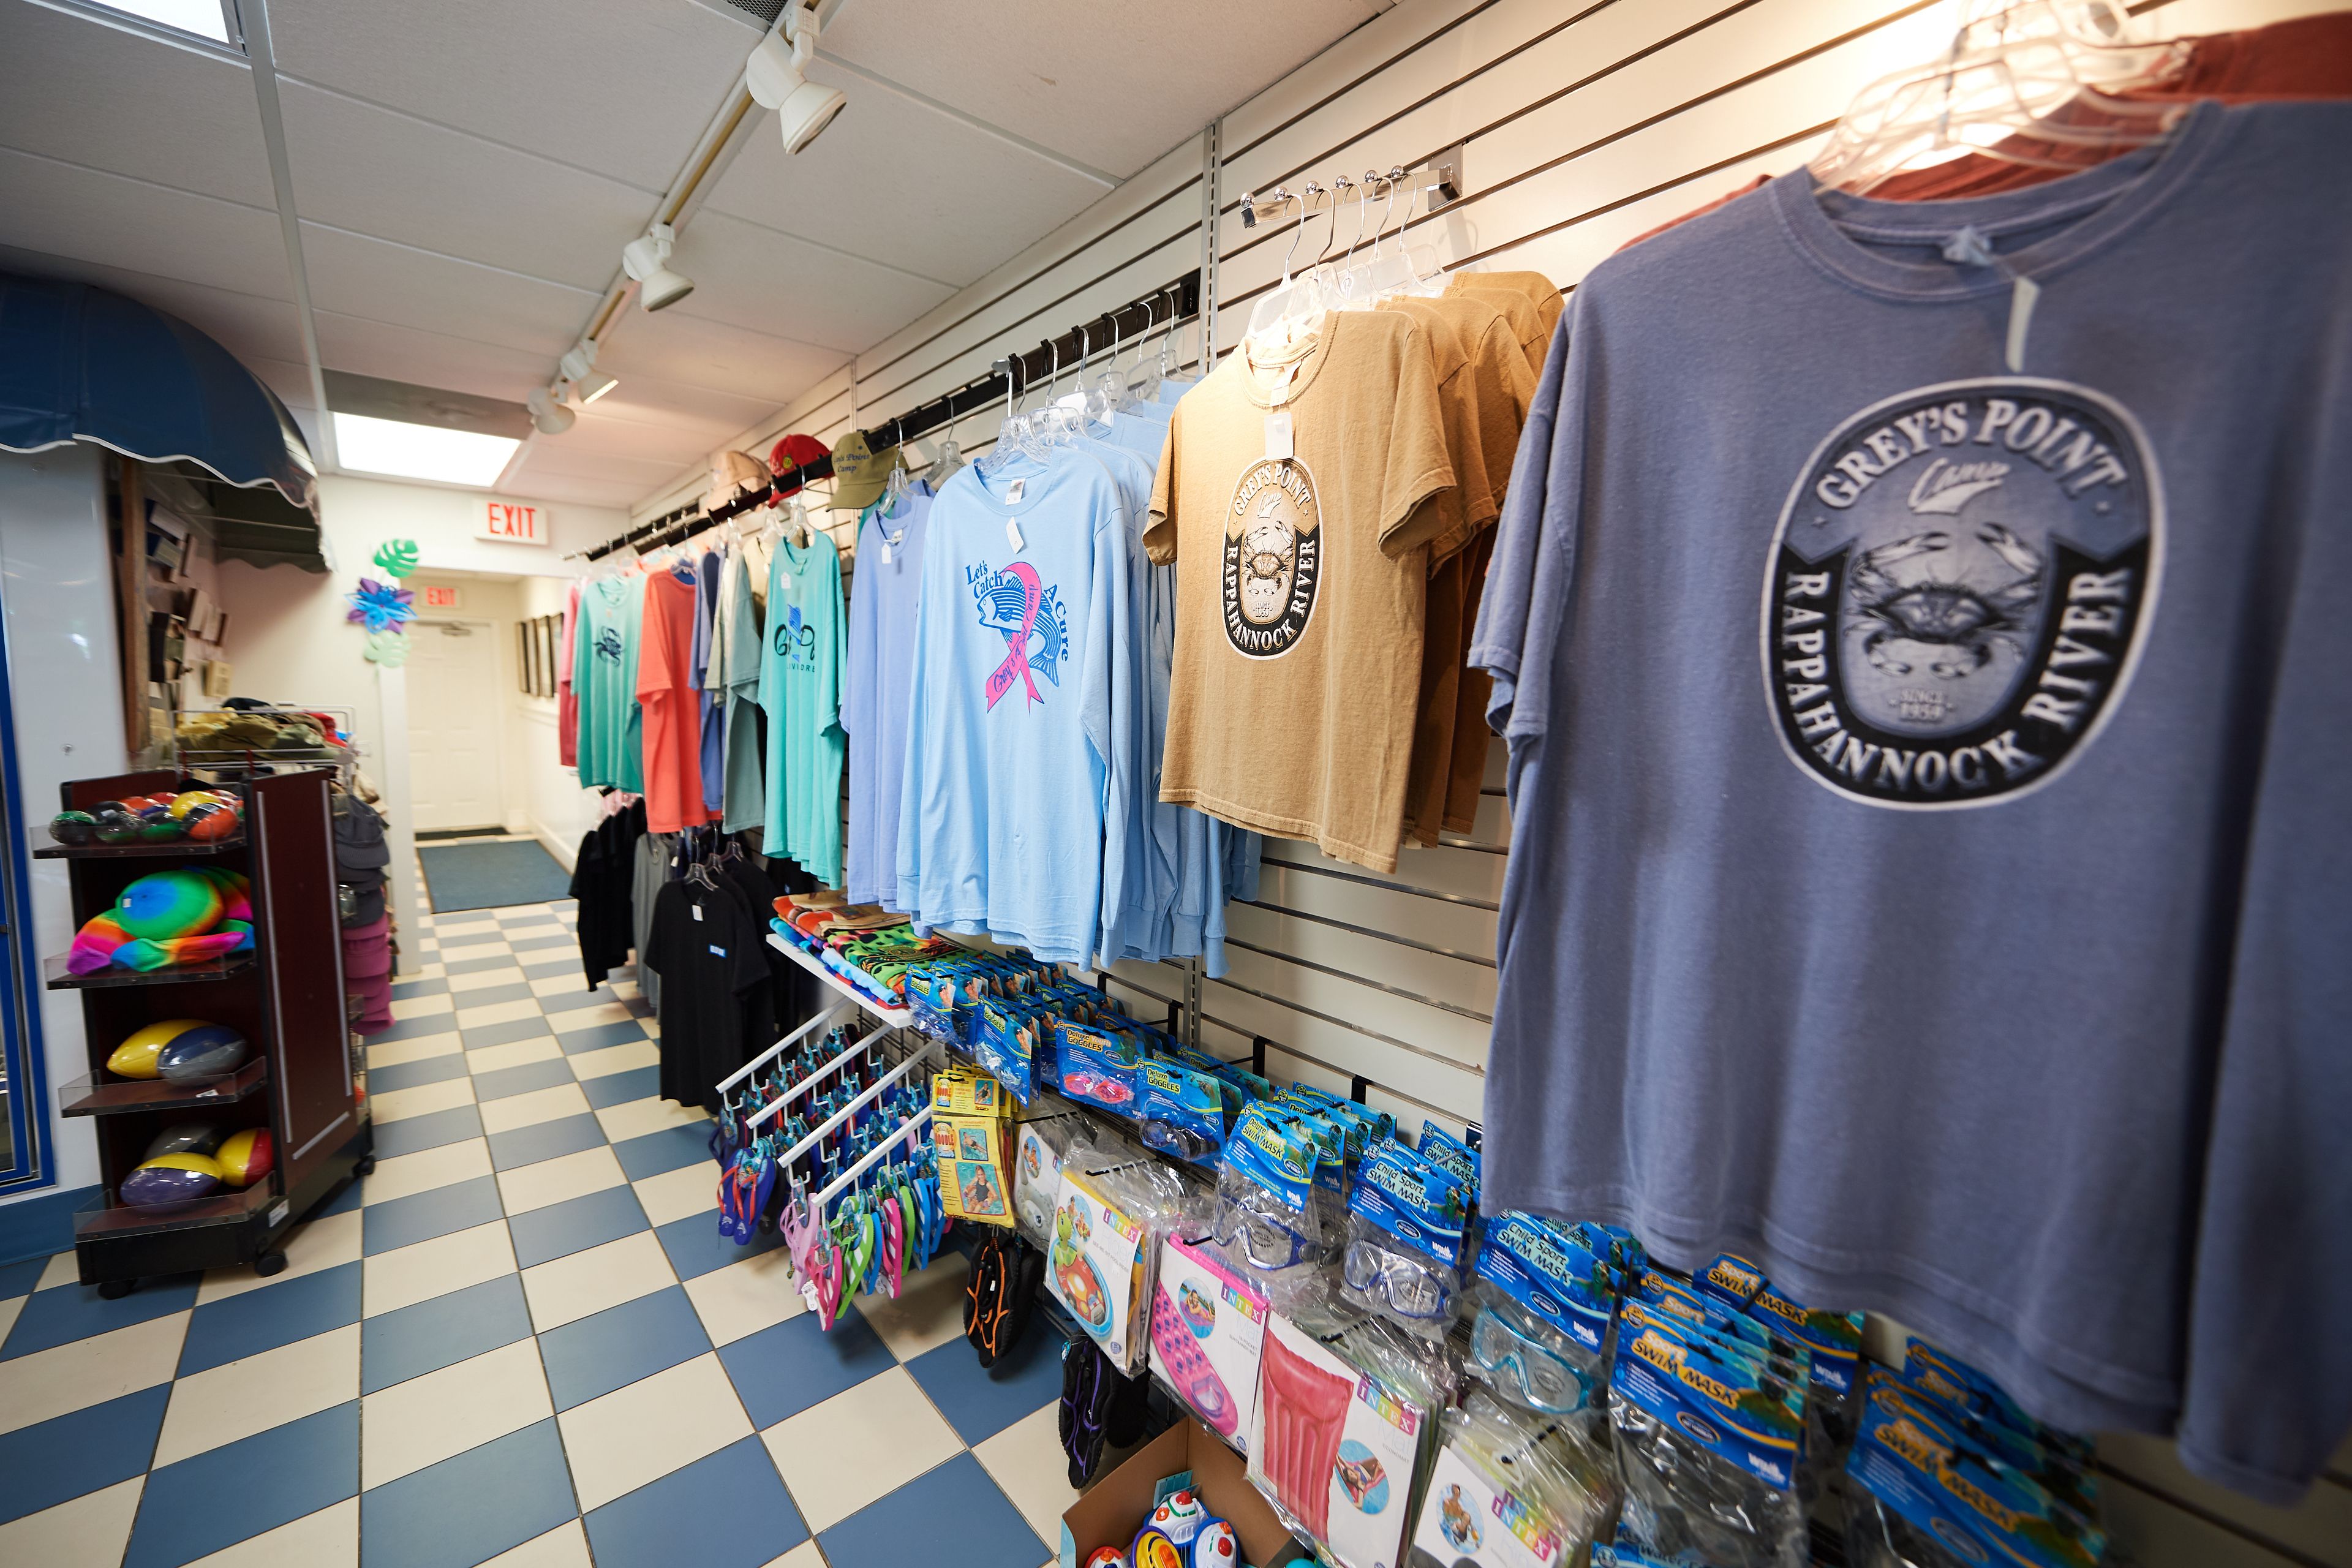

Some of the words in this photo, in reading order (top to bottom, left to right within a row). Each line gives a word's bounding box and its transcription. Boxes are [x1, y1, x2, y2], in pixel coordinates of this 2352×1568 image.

[1815, 402, 1968, 508] GREY'S
[1974, 400, 2127, 499] POINT
[1234, 464, 1272, 516] GREY'S
[1273, 463, 1311, 509] POINT
[488, 502, 537, 538] EXIT
[965, 560, 989, 585] Let's
[973, 570, 1004, 599] Catch
[426, 586, 456, 606] EXIT
[1226, 546, 1298, 650] RAPPAHANNOCK
[1290, 540, 1316, 617] RIVER
[1044, 584, 1058, 603] A
[1055, 600, 1069, 662] Cure
[1256, 608, 1270, 617] 1959
[1782, 571, 2045, 789] RAPPAHANNOCK
[2021, 568, 2133, 732] RIVER
[984, 1011, 1005, 1033] GOGGLES
[1067, 1030, 1090, 1040] Deluxe
[1068, 1036, 1102, 1051] GOGGLES
[1147, 1069, 1168, 1080] Deluxe
[1148, 1077, 1180, 1092] GOGGLES
[1242, 1126, 1260, 1144] SWIM
[1260, 1139, 1283, 1158] MASK
[1248, 1118, 1266, 1134] Deluxe
[1433, 1141, 1450, 1157] Child
[1368, 1169, 1395, 1192] SWIM
[1399, 1188, 1430, 1210] MASK
[1377, 1163, 1398, 1179] Child
[1399, 1175, 1424, 1194] Sport
[1450, 1166, 1477, 1187] MASK
[1104, 1210, 1139, 1242] INTEX
[1499, 1231, 1531, 1258] SWIM
[1534, 1256, 1571, 1284] MASK
[1509, 1223, 1535, 1244] Child
[1536, 1239, 1567, 1266] Sport
[1719, 1261, 1757, 1286] Sport
[1222, 1286, 1262, 1323] INTEX
[1666, 1297, 1703, 1327] Sport
[1757, 1292, 1803, 1324] MASK
[1644, 1332, 1686, 1361] Sport
[1635, 1340, 1679, 1376] SWIM
[1684, 1369, 1736, 1405] MASK
[1359, 1383, 1414, 1433] INTEX
[1946, 1476, 2011, 1525] MASK
[1493, 1498, 1550, 1559] INTEX
